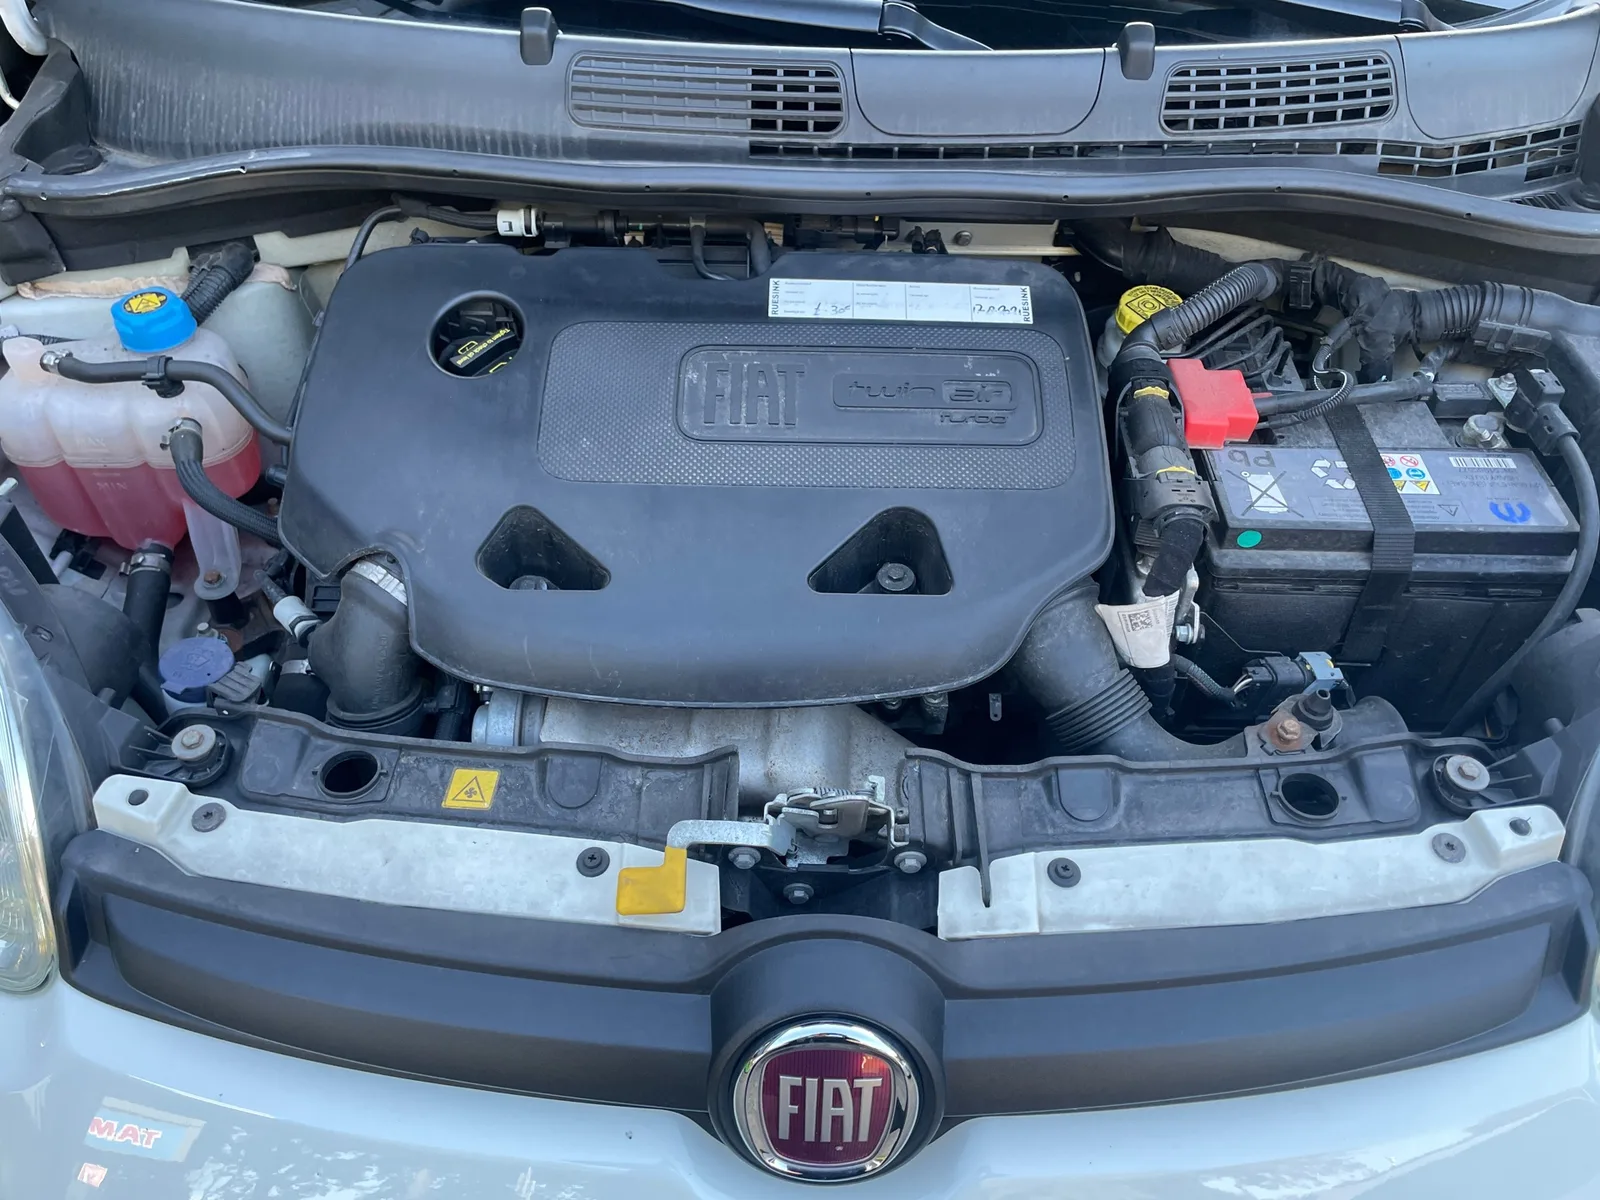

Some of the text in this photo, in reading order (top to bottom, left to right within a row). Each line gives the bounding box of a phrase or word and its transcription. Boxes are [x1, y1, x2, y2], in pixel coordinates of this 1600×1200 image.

[771, 280, 780, 315] RUESINK
[1020, 287, 1031, 322] RUESINK
[702, 361, 806, 427] FIAT
[938, 413, 1010, 425] turbo
[1227, 450, 1276, 468] Pb
[96, 482, 128, 492] MIN
[778, 1075, 883, 1143] FIAT
